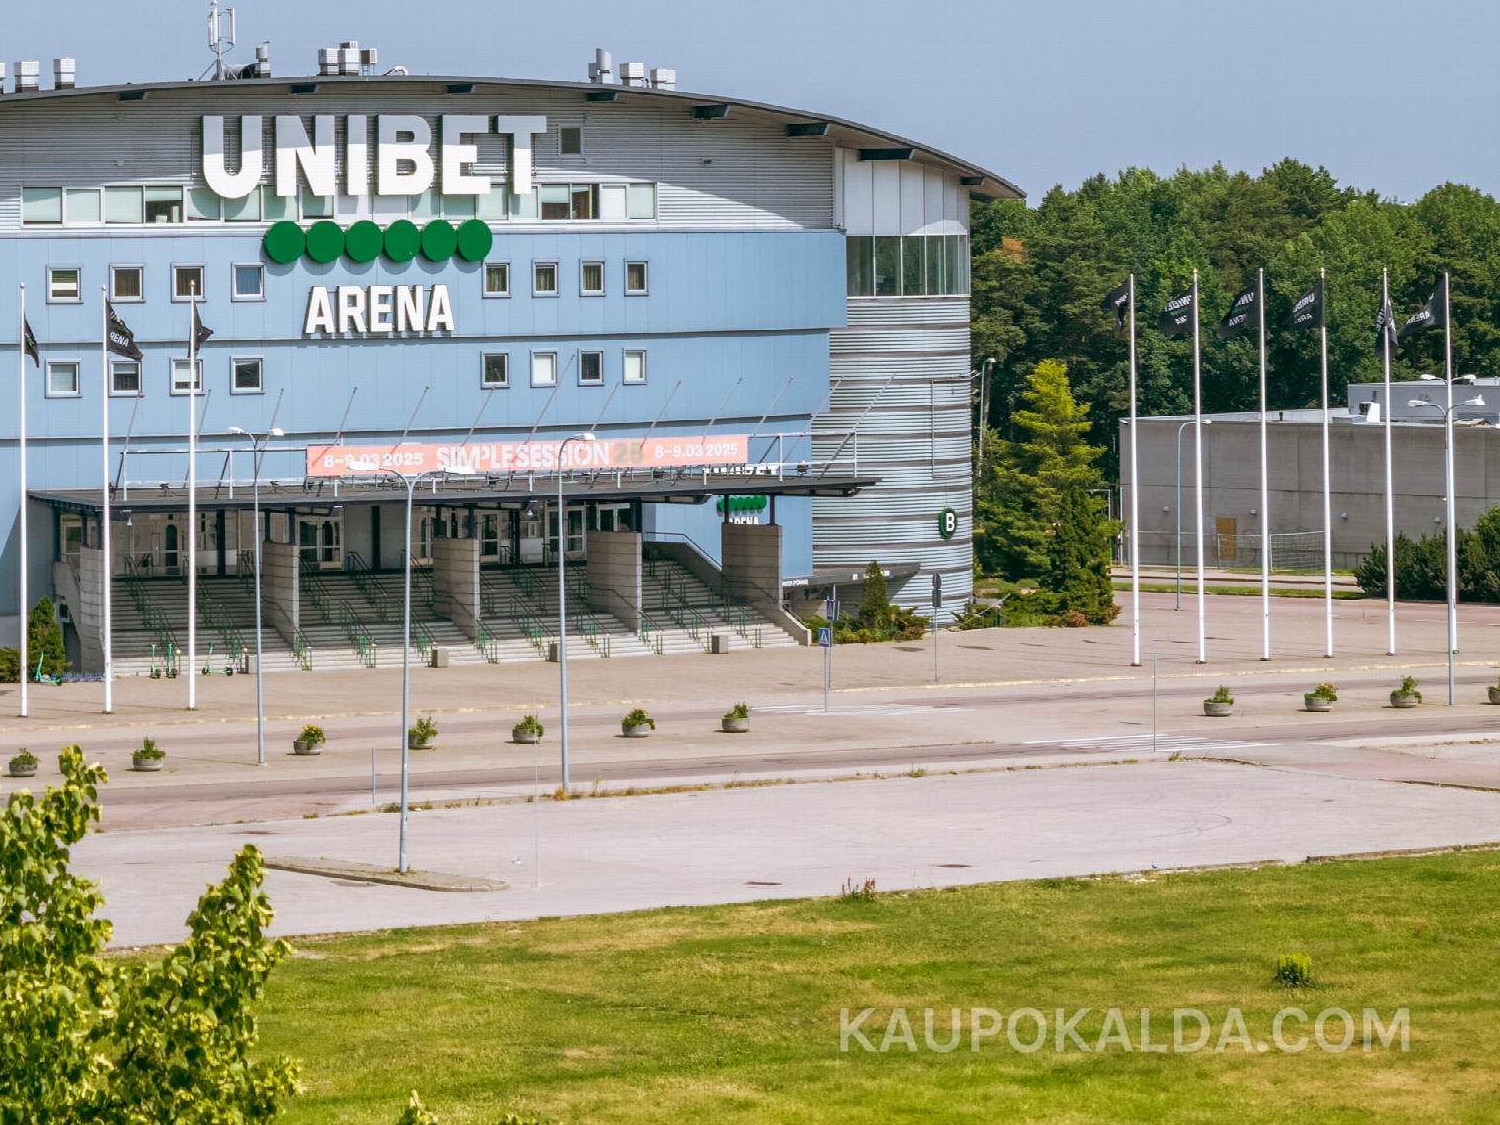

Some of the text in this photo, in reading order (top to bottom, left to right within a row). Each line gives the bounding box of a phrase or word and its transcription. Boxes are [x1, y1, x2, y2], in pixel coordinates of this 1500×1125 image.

[202, 114, 547, 199] UNIBET
[304, 284, 455, 334] ARENA
[383, 452, 424, 466] 2025
[946, 512, 955, 532] B
